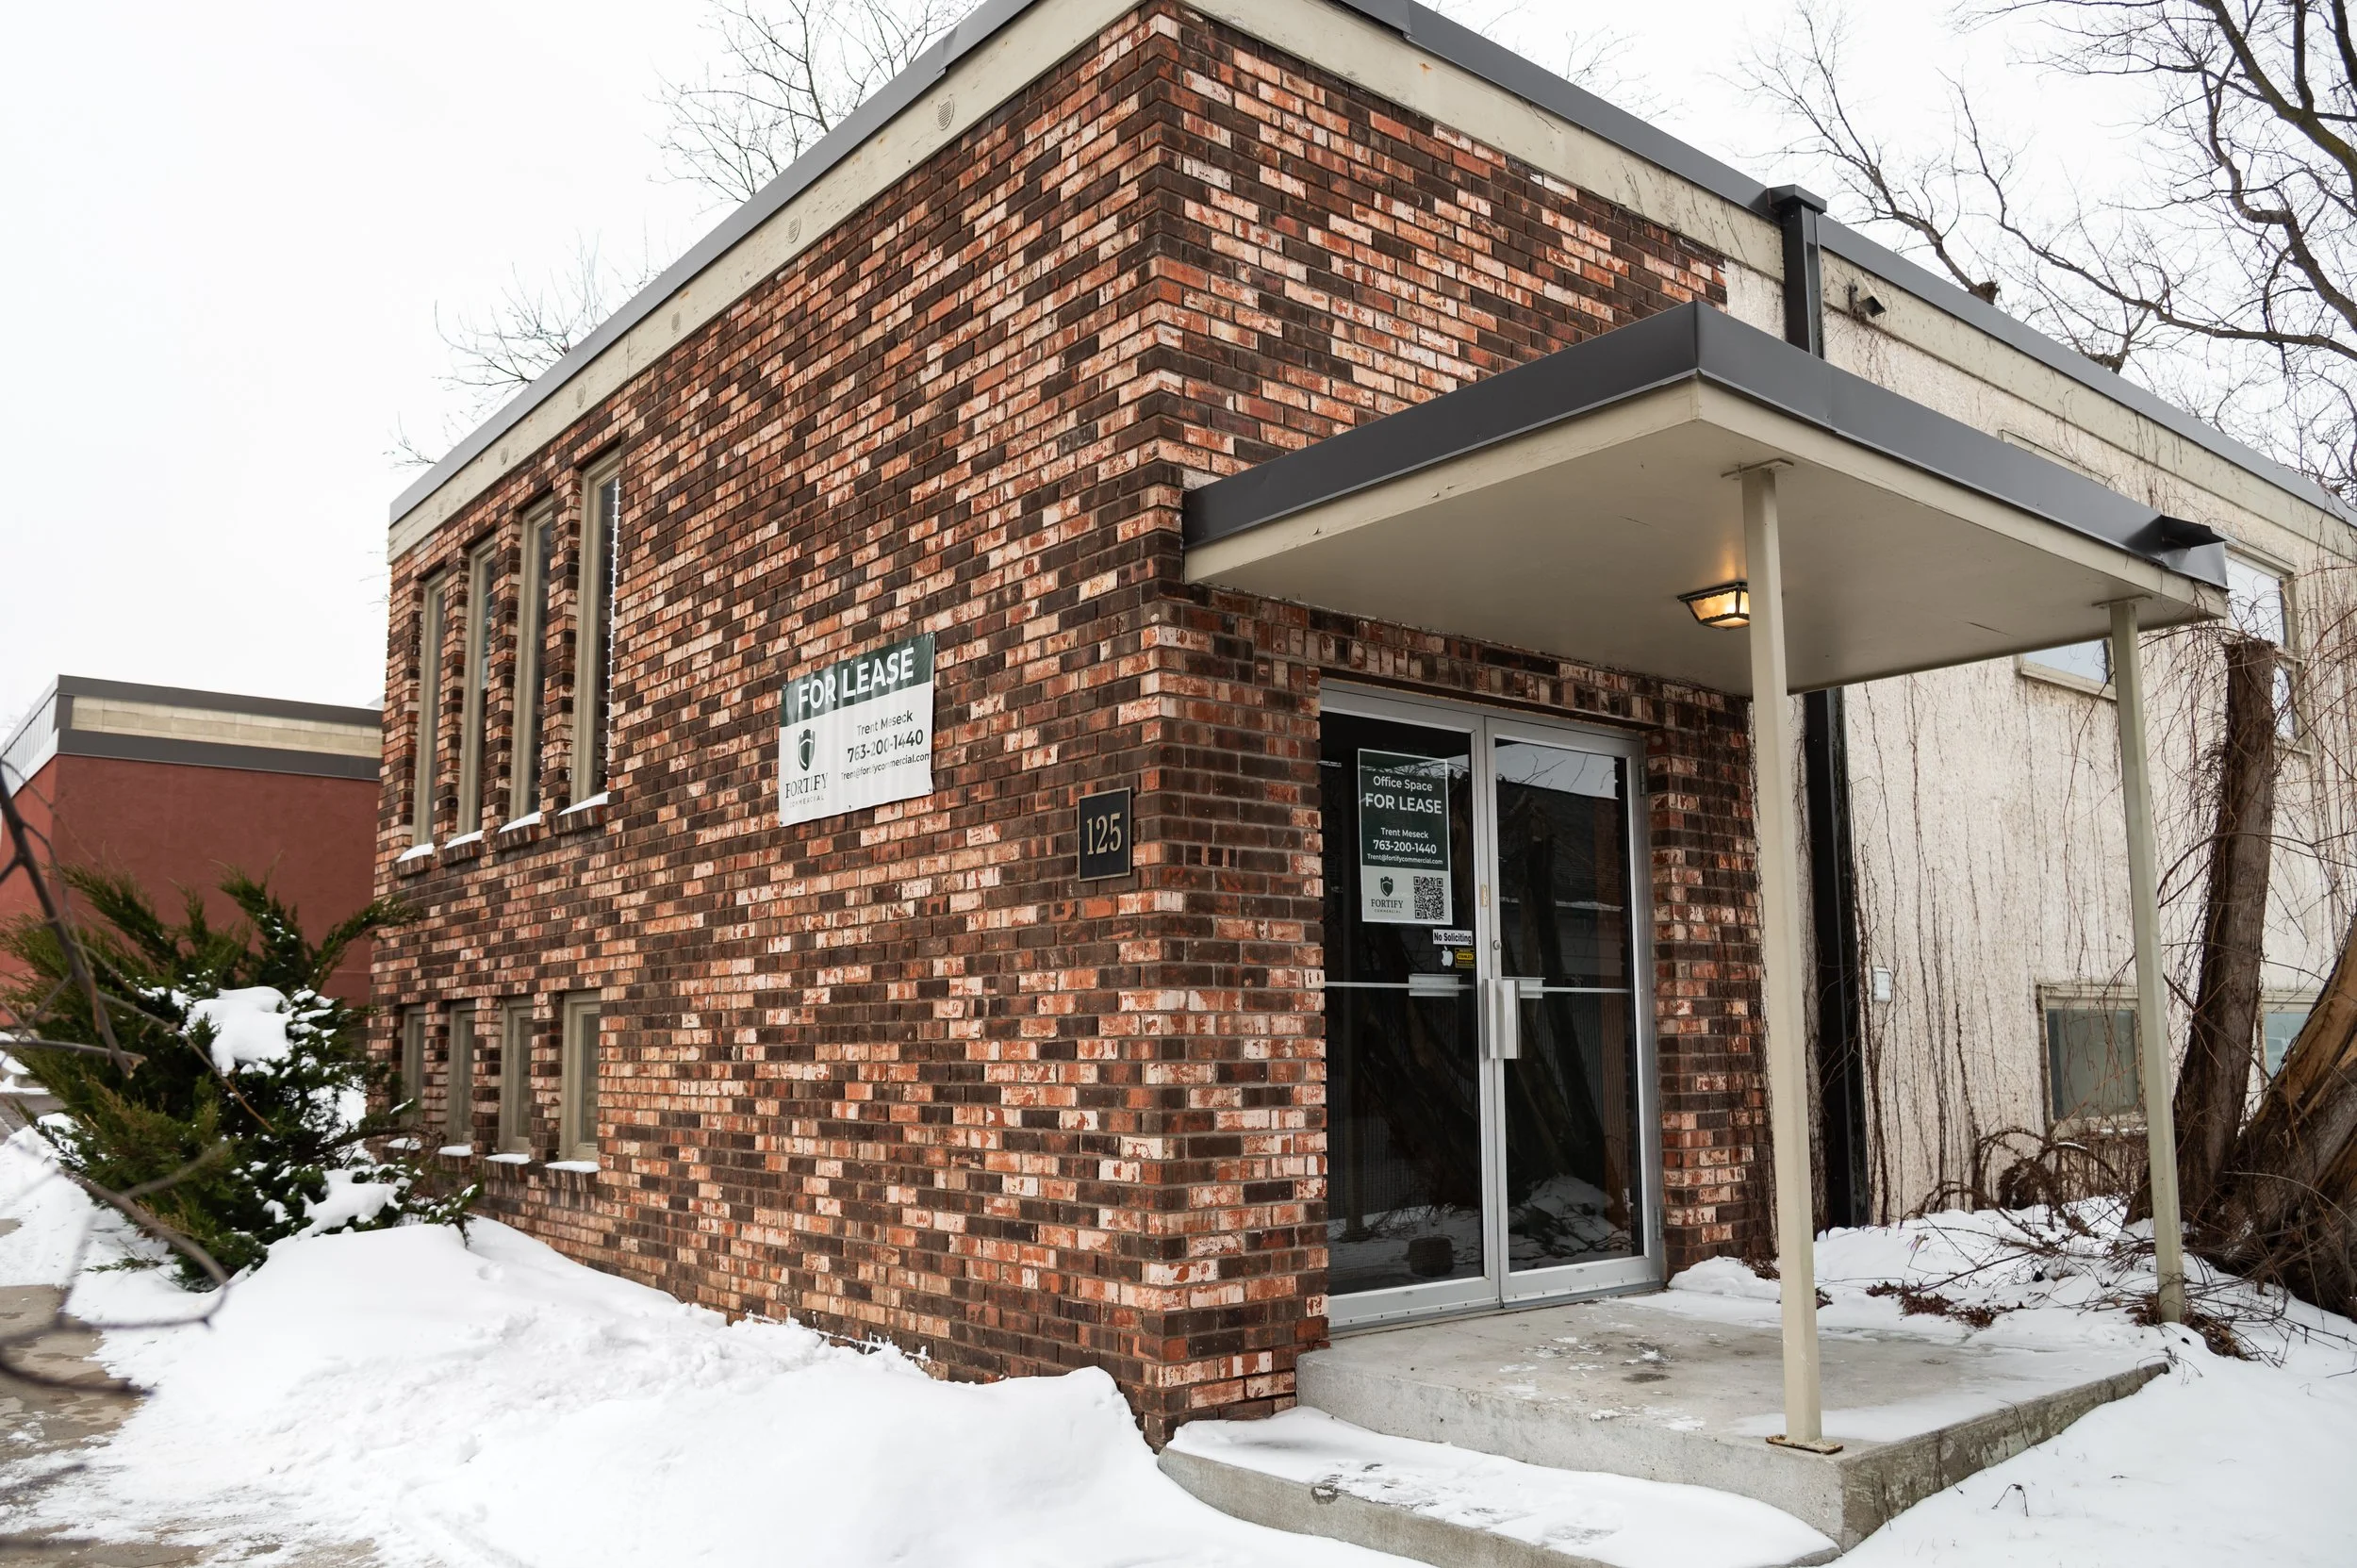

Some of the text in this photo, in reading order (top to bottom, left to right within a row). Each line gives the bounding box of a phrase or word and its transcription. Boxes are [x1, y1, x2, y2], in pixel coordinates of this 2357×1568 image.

[798, 647, 914, 714] FOR LEASE
[857, 710, 913, 735] Trent Meseck
[848, 729, 923, 763] 763-200-1440
[785, 772, 828, 799] FORTIFY
[1373, 776, 1433, 792] Office Space
[1365, 792, 1442, 815] FOR LEASE
[1087, 812, 1122, 855] 125
[1380, 827, 1429, 839] Trent Meseck
[1373, 839, 1437, 854] 763-200-1440
[1367, 853, 1443, 865] Trent@fortifycommercial.com
[1371, 899, 1404, 909] FORTIFY
[1434, 933, 1472, 944] No Soliciting
